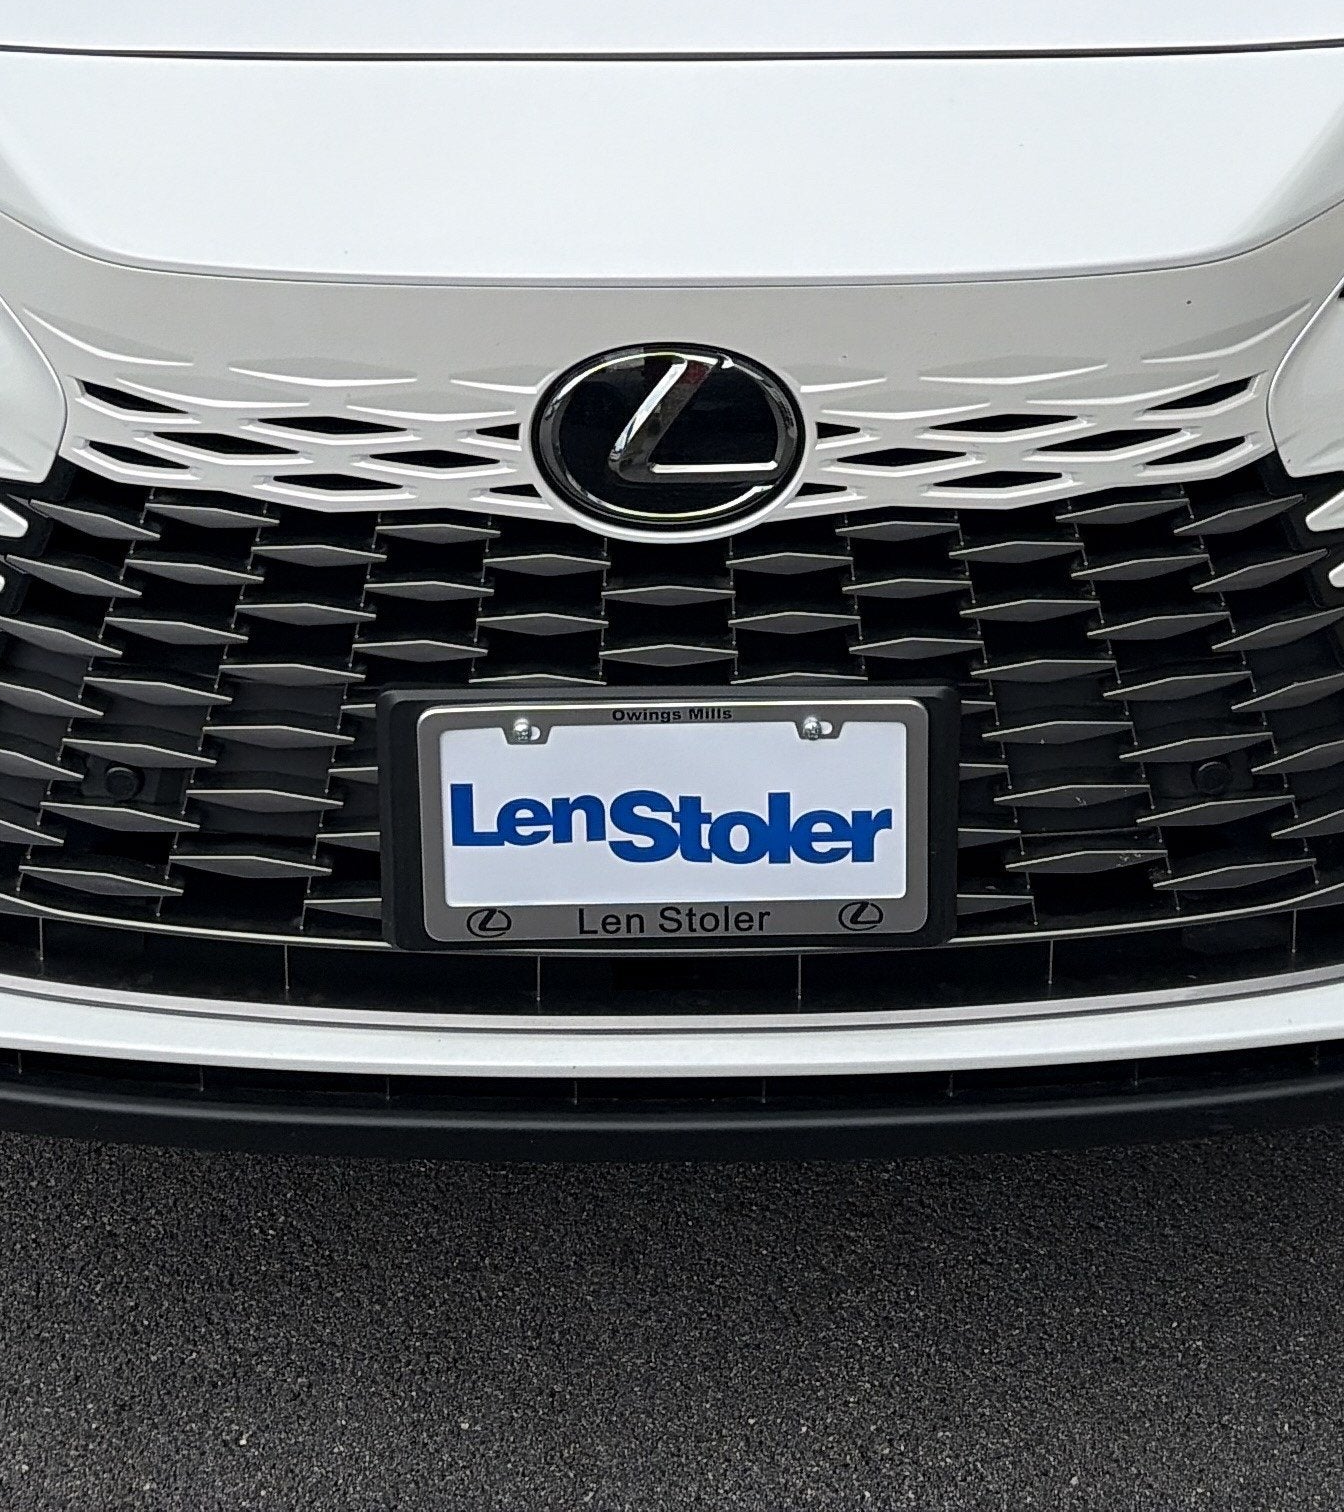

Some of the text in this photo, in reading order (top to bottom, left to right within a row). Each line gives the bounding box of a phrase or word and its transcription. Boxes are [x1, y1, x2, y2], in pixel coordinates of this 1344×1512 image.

[612, 707, 733, 723] Owings Mills
[450, 783, 893, 864] LenStoler
[578, 905, 771, 935] Len Stoler
